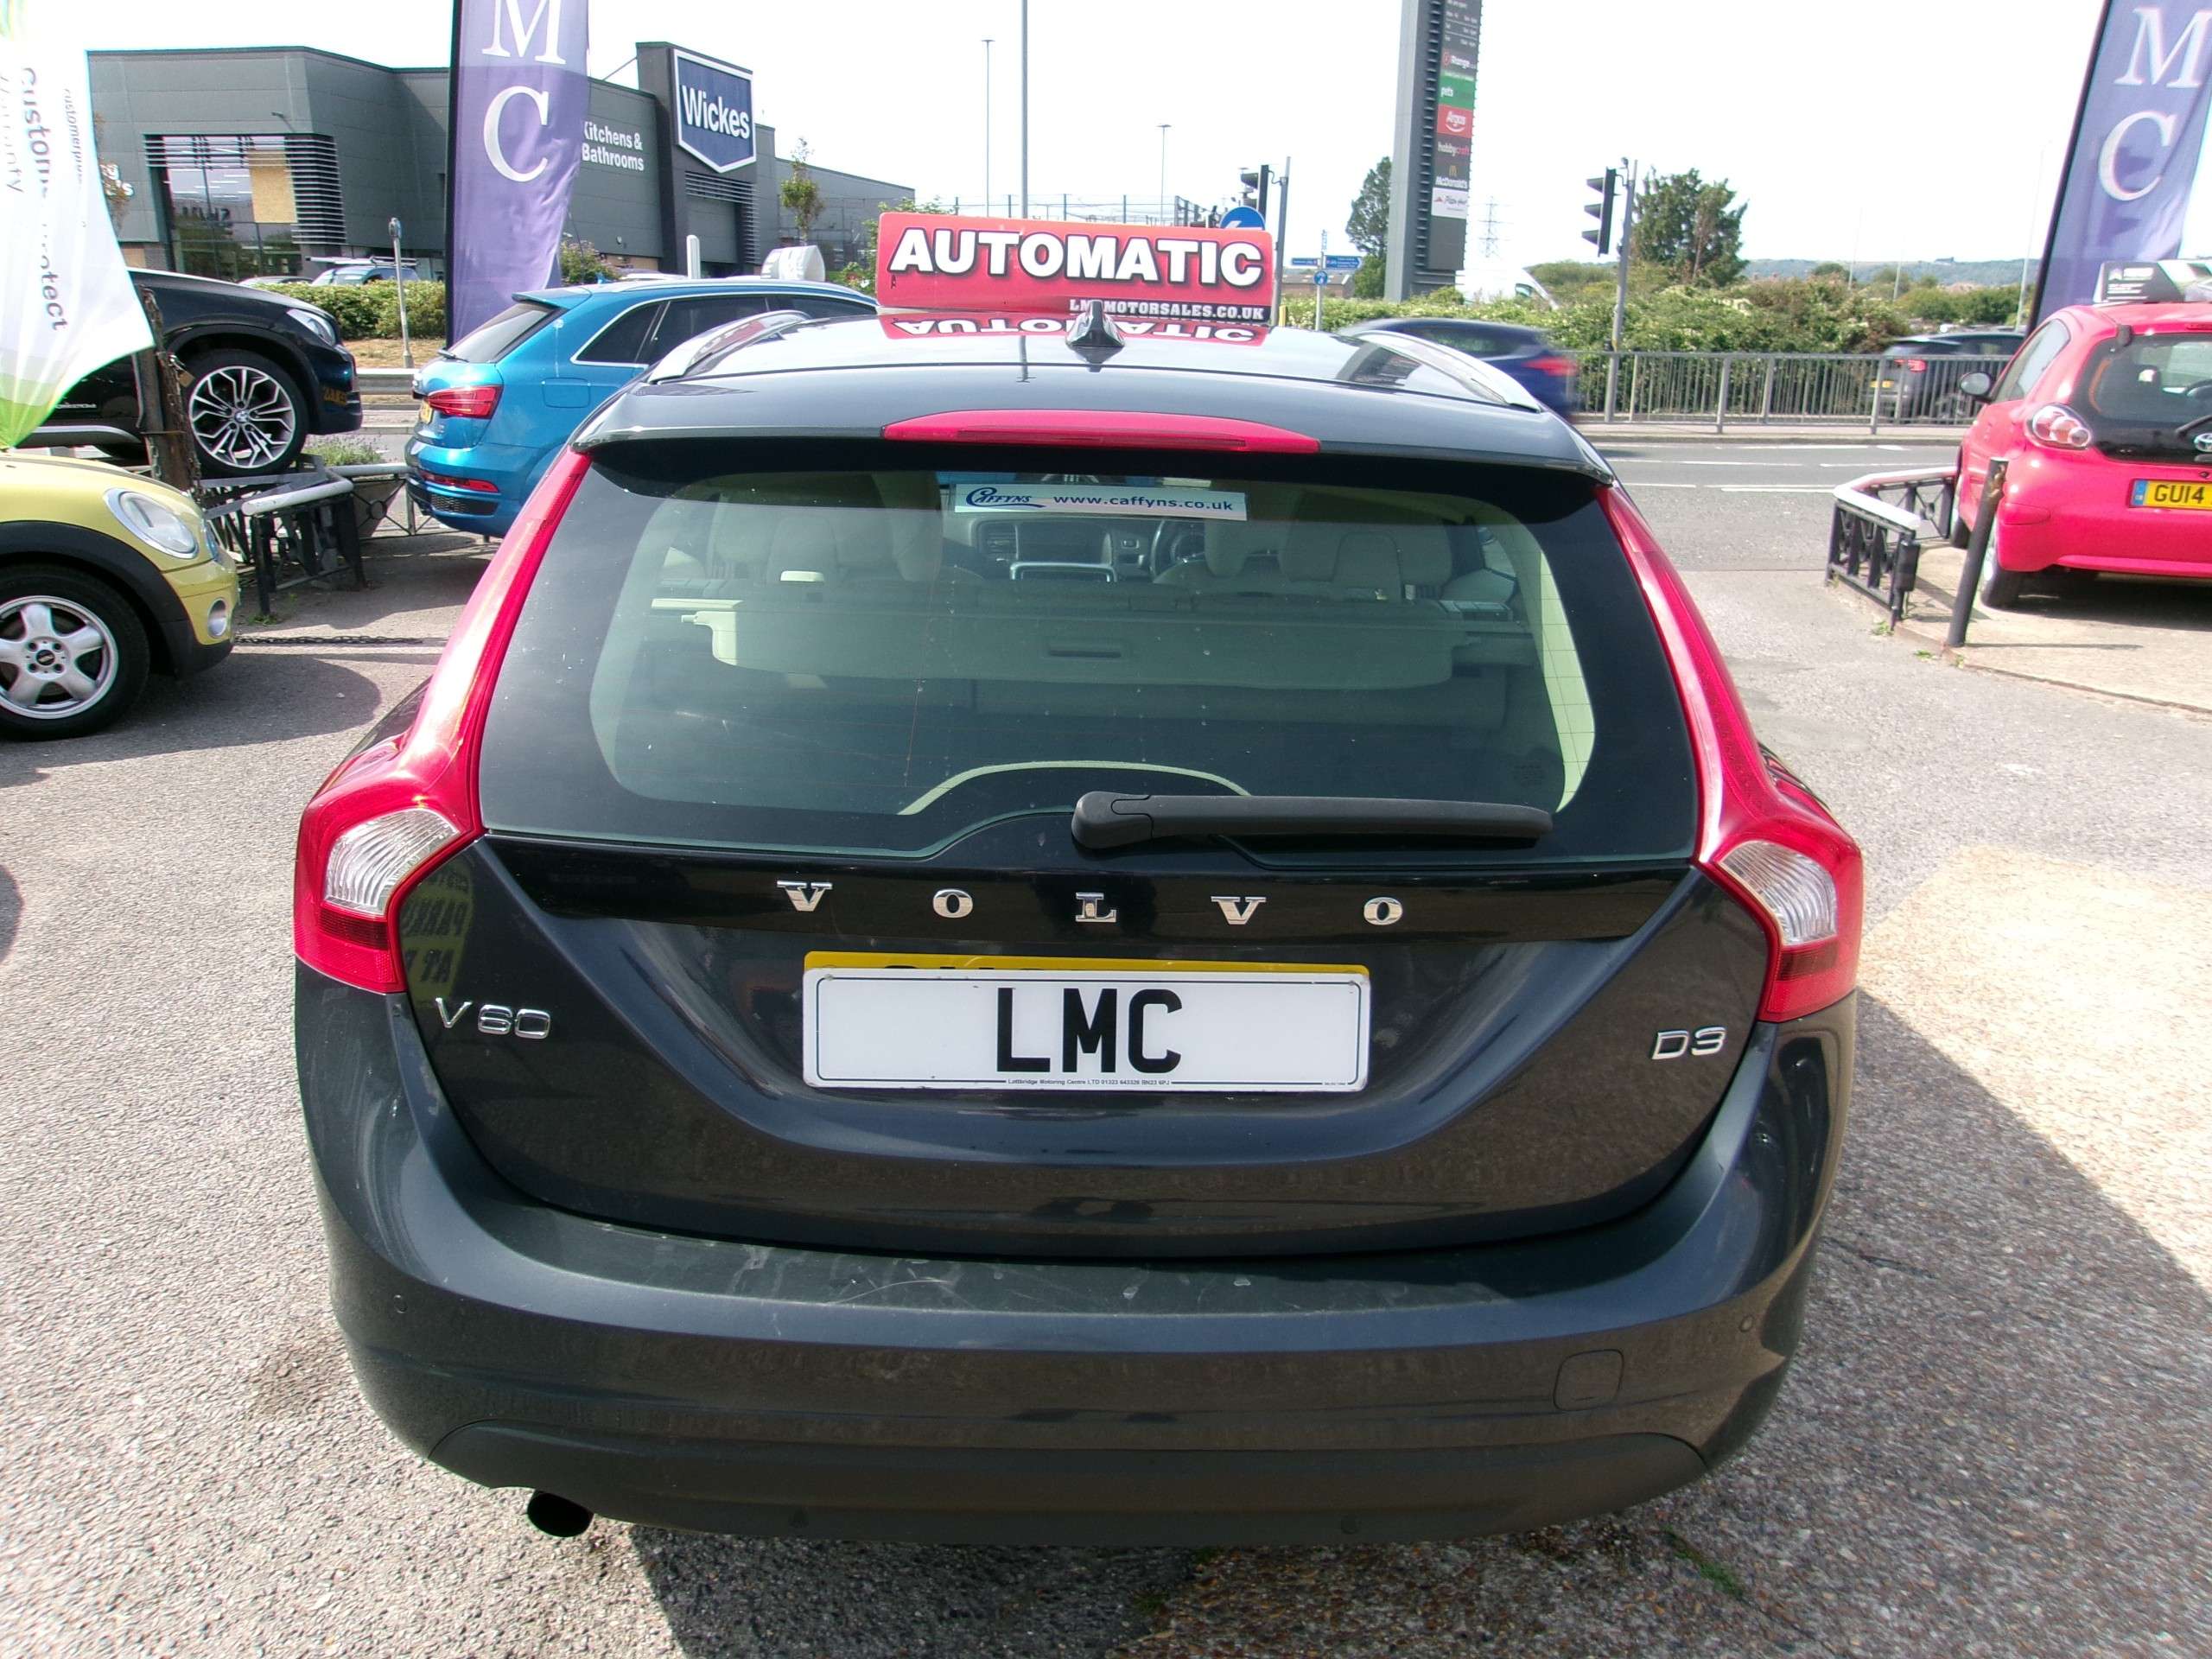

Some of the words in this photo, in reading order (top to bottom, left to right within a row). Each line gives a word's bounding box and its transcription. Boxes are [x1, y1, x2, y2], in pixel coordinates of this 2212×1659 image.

[683, 85, 750, 139] Wickes
[582, 143, 644, 171] Bathrooms
[634, 132, 643, 150] &
[888, 228, 1263, 287] AUTOMATIC
[1069, 299, 1264, 320] LMMOTORSALES.CO.UK
[1053, 495, 1233, 512] www.caffyns.co.uk
[2154, 484, 2205, 505] GU14
[777, 880, 1404, 926] VOLVO
[435, 997, 550, 1039] V60
[997, 988, 1182, 1073] LMC
[1652, 1027, 1726, 1060] D3
